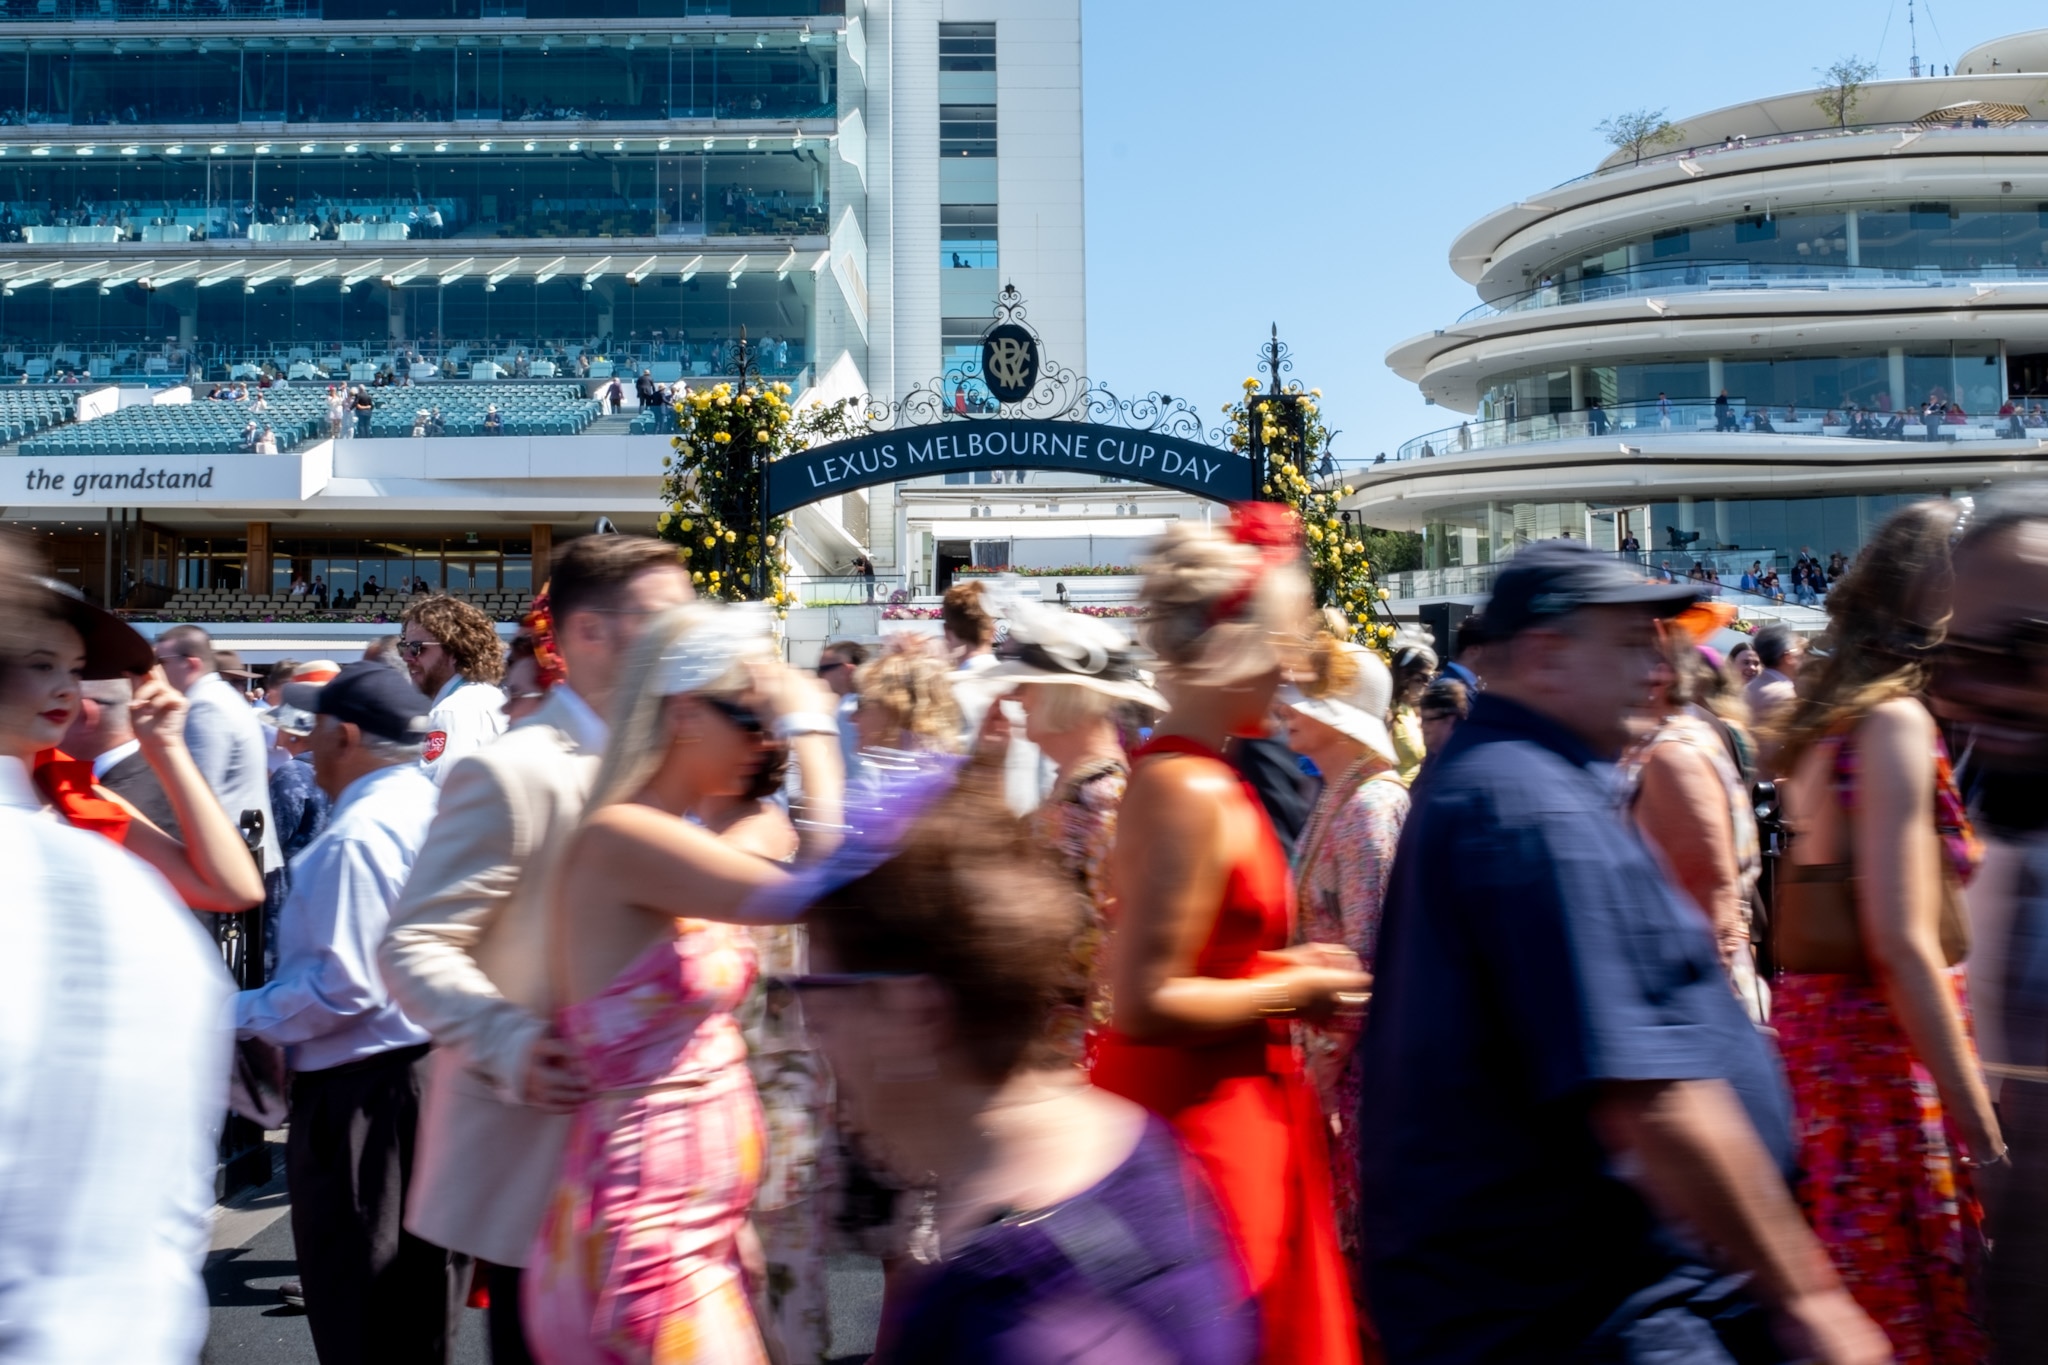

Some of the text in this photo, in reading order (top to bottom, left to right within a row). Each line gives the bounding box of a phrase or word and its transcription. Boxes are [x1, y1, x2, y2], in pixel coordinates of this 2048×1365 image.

[807, 431, 1221, 487] LEXUS MELBOURNE CUP DAY
[26, 466, 214, 496] the grandstand
